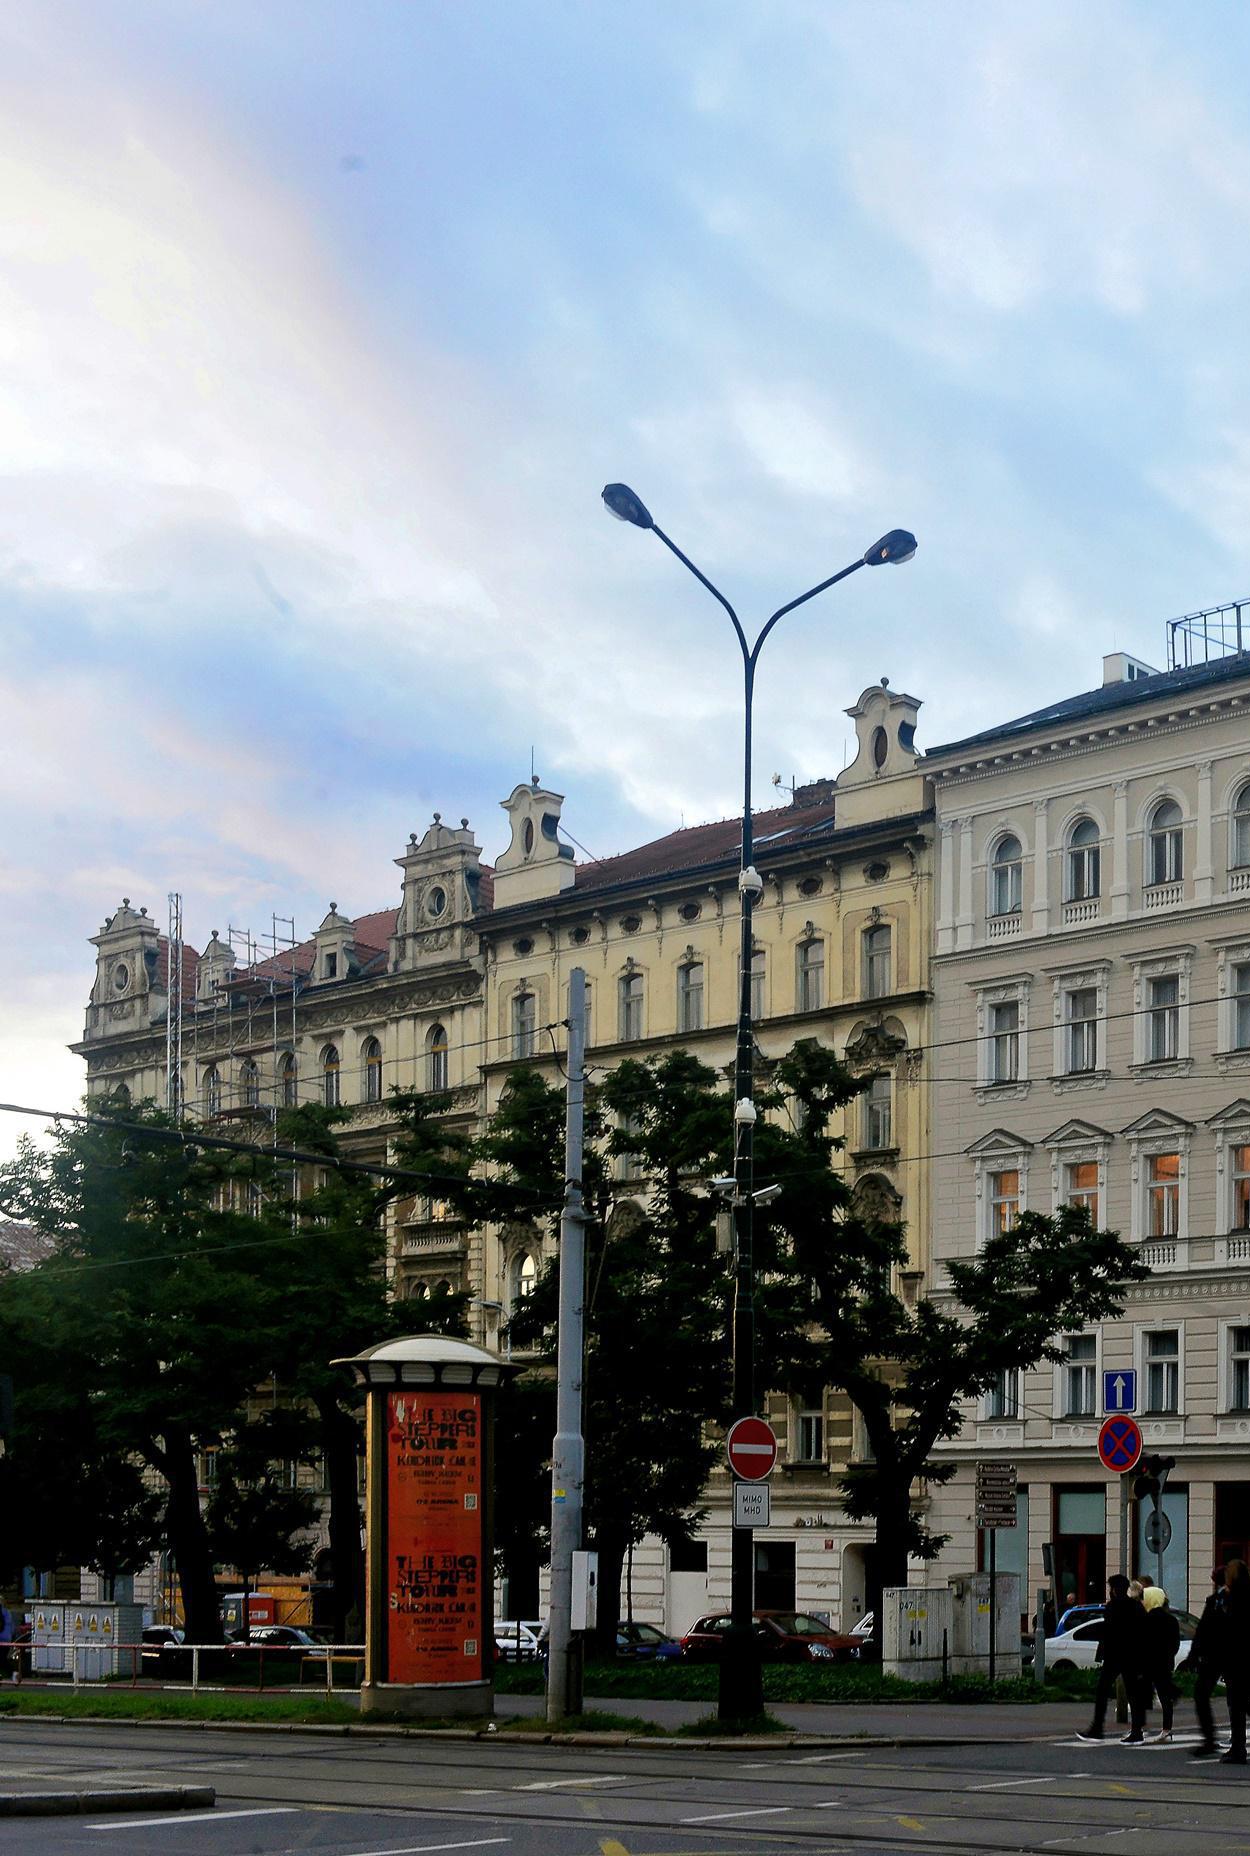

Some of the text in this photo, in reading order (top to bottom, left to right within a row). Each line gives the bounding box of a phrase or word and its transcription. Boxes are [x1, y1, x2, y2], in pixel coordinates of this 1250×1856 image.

[441, 1408, 477, 1422] BIG
[742, 1495, 763, 1504] MIMO
[743, 1505, 761, 1515] MHD
[396, 1555, 477, 1569] THE BIG
